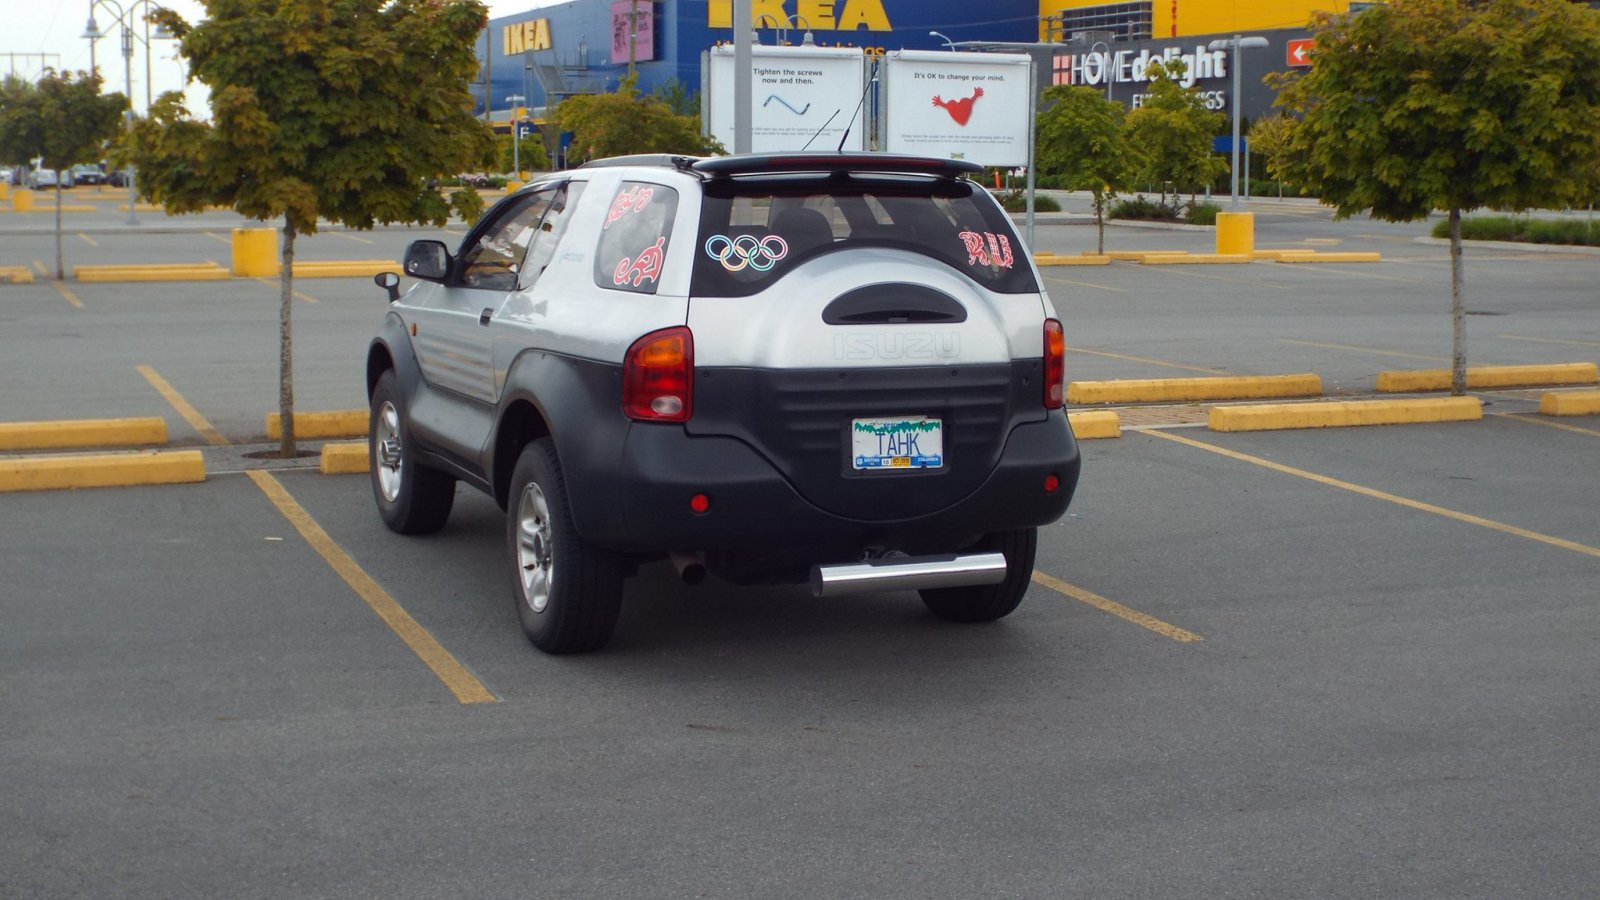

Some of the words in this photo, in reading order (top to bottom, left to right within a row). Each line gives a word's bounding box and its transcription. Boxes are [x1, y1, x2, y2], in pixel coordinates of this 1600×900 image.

[708, 0, 893, 32] IKEA
[504, 17, 552, 56] IKEA
[753, 68, 781, 76] Tighten
[783, 68, 795, 76] the
[833, 331, 962, 361] ISUZU
[875, 432, 920, 456] TAHK
